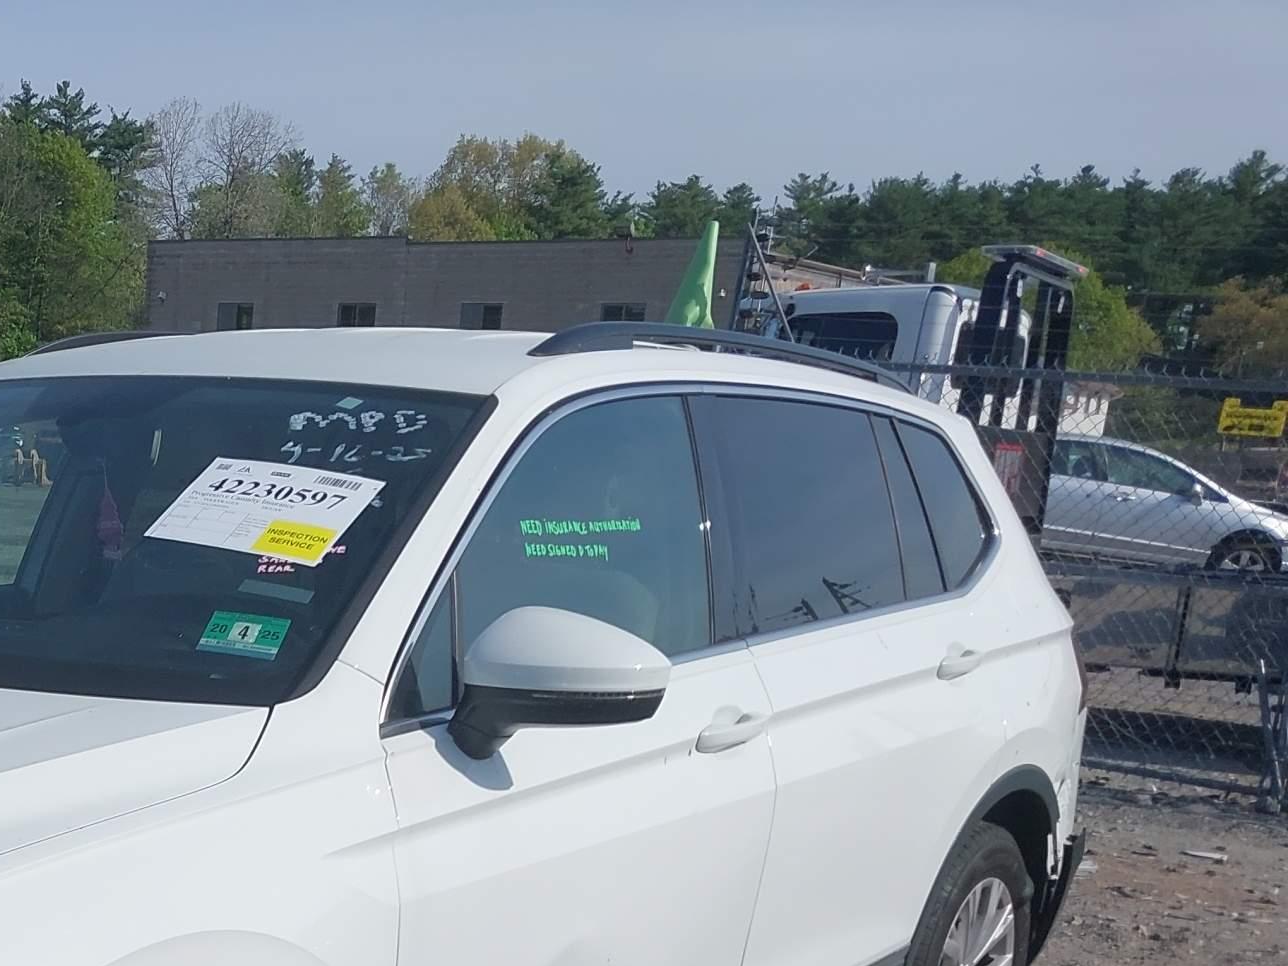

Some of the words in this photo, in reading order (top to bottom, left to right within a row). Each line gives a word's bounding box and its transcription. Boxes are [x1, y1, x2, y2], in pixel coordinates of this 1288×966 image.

[208, 478, 348, 510] 42230597
[266, 527, 328, 544] INSPECTION
[520, 519, 542, 536] NEED
[268, 537, 314, 551] SERVICE
[257, 564, 295, 574] REAR
[209, 623, 228, 633] 20
[238, 625, 250, 640] 4
[260, 630, 281, 641] 25
